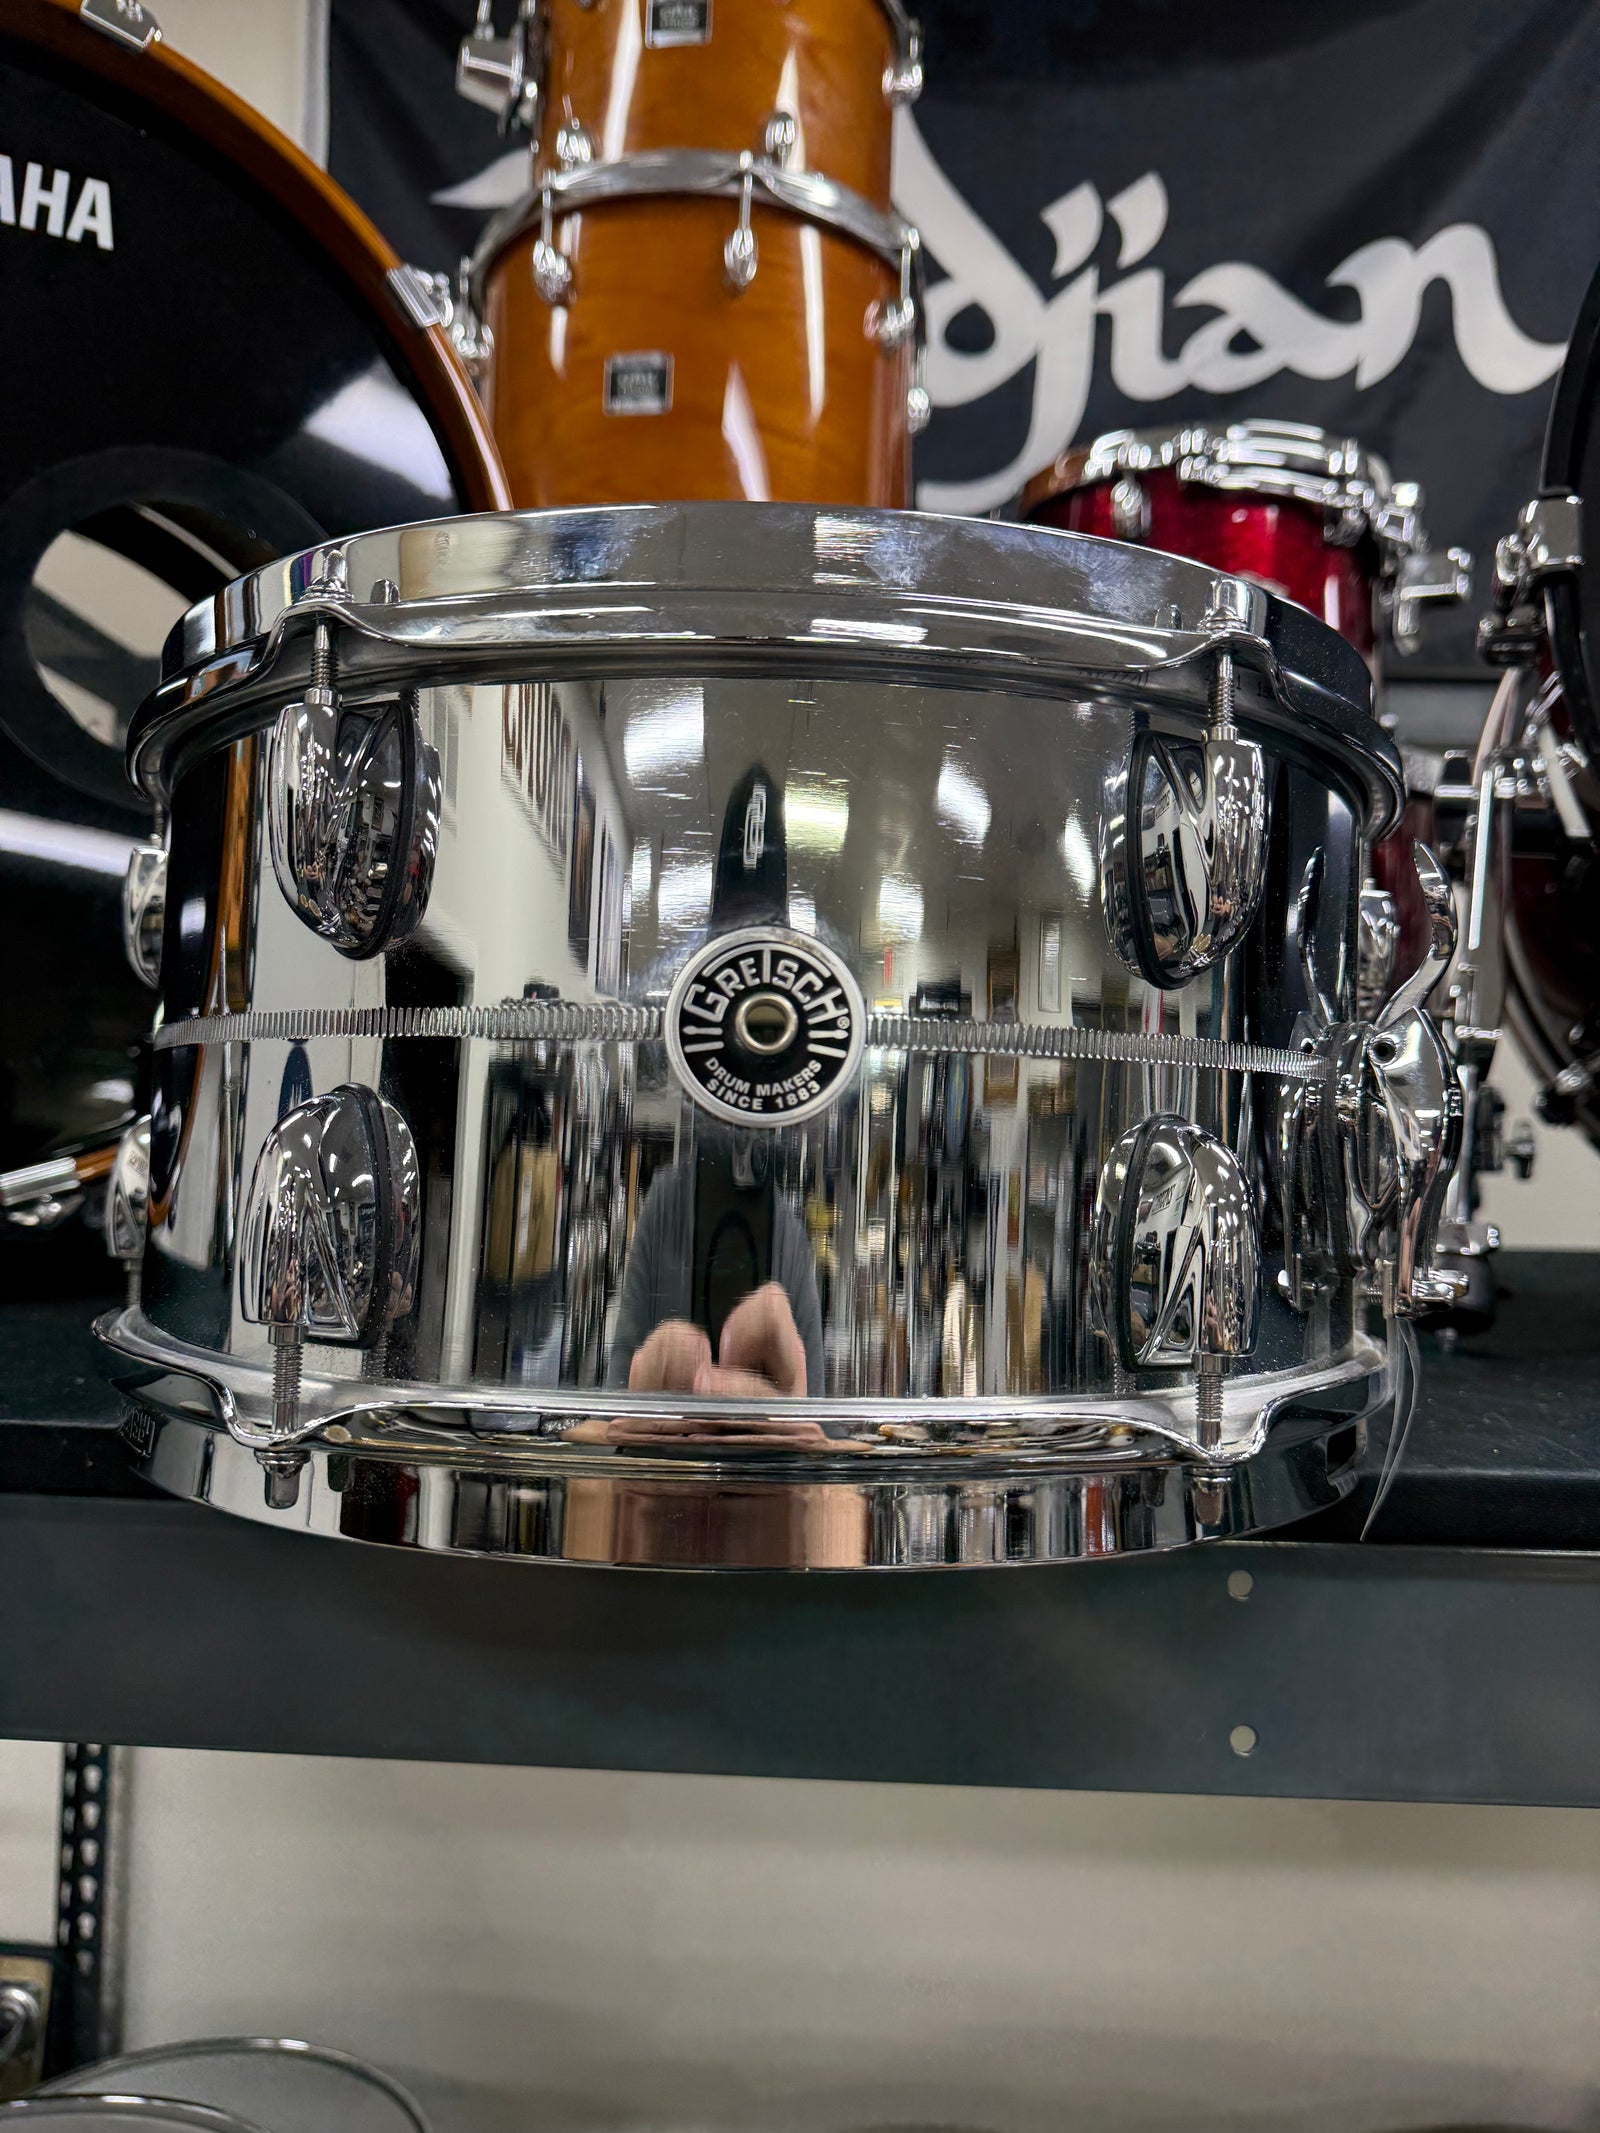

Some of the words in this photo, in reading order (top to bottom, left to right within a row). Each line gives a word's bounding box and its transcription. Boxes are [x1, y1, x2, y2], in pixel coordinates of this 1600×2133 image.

[705, 1057, 751, 1094] DRUM
[756, 1059, 822, 1097] MAKERS
[706, 1078, 764, 1110] SINCE
[775, 1080, 821, 1109] 1883
